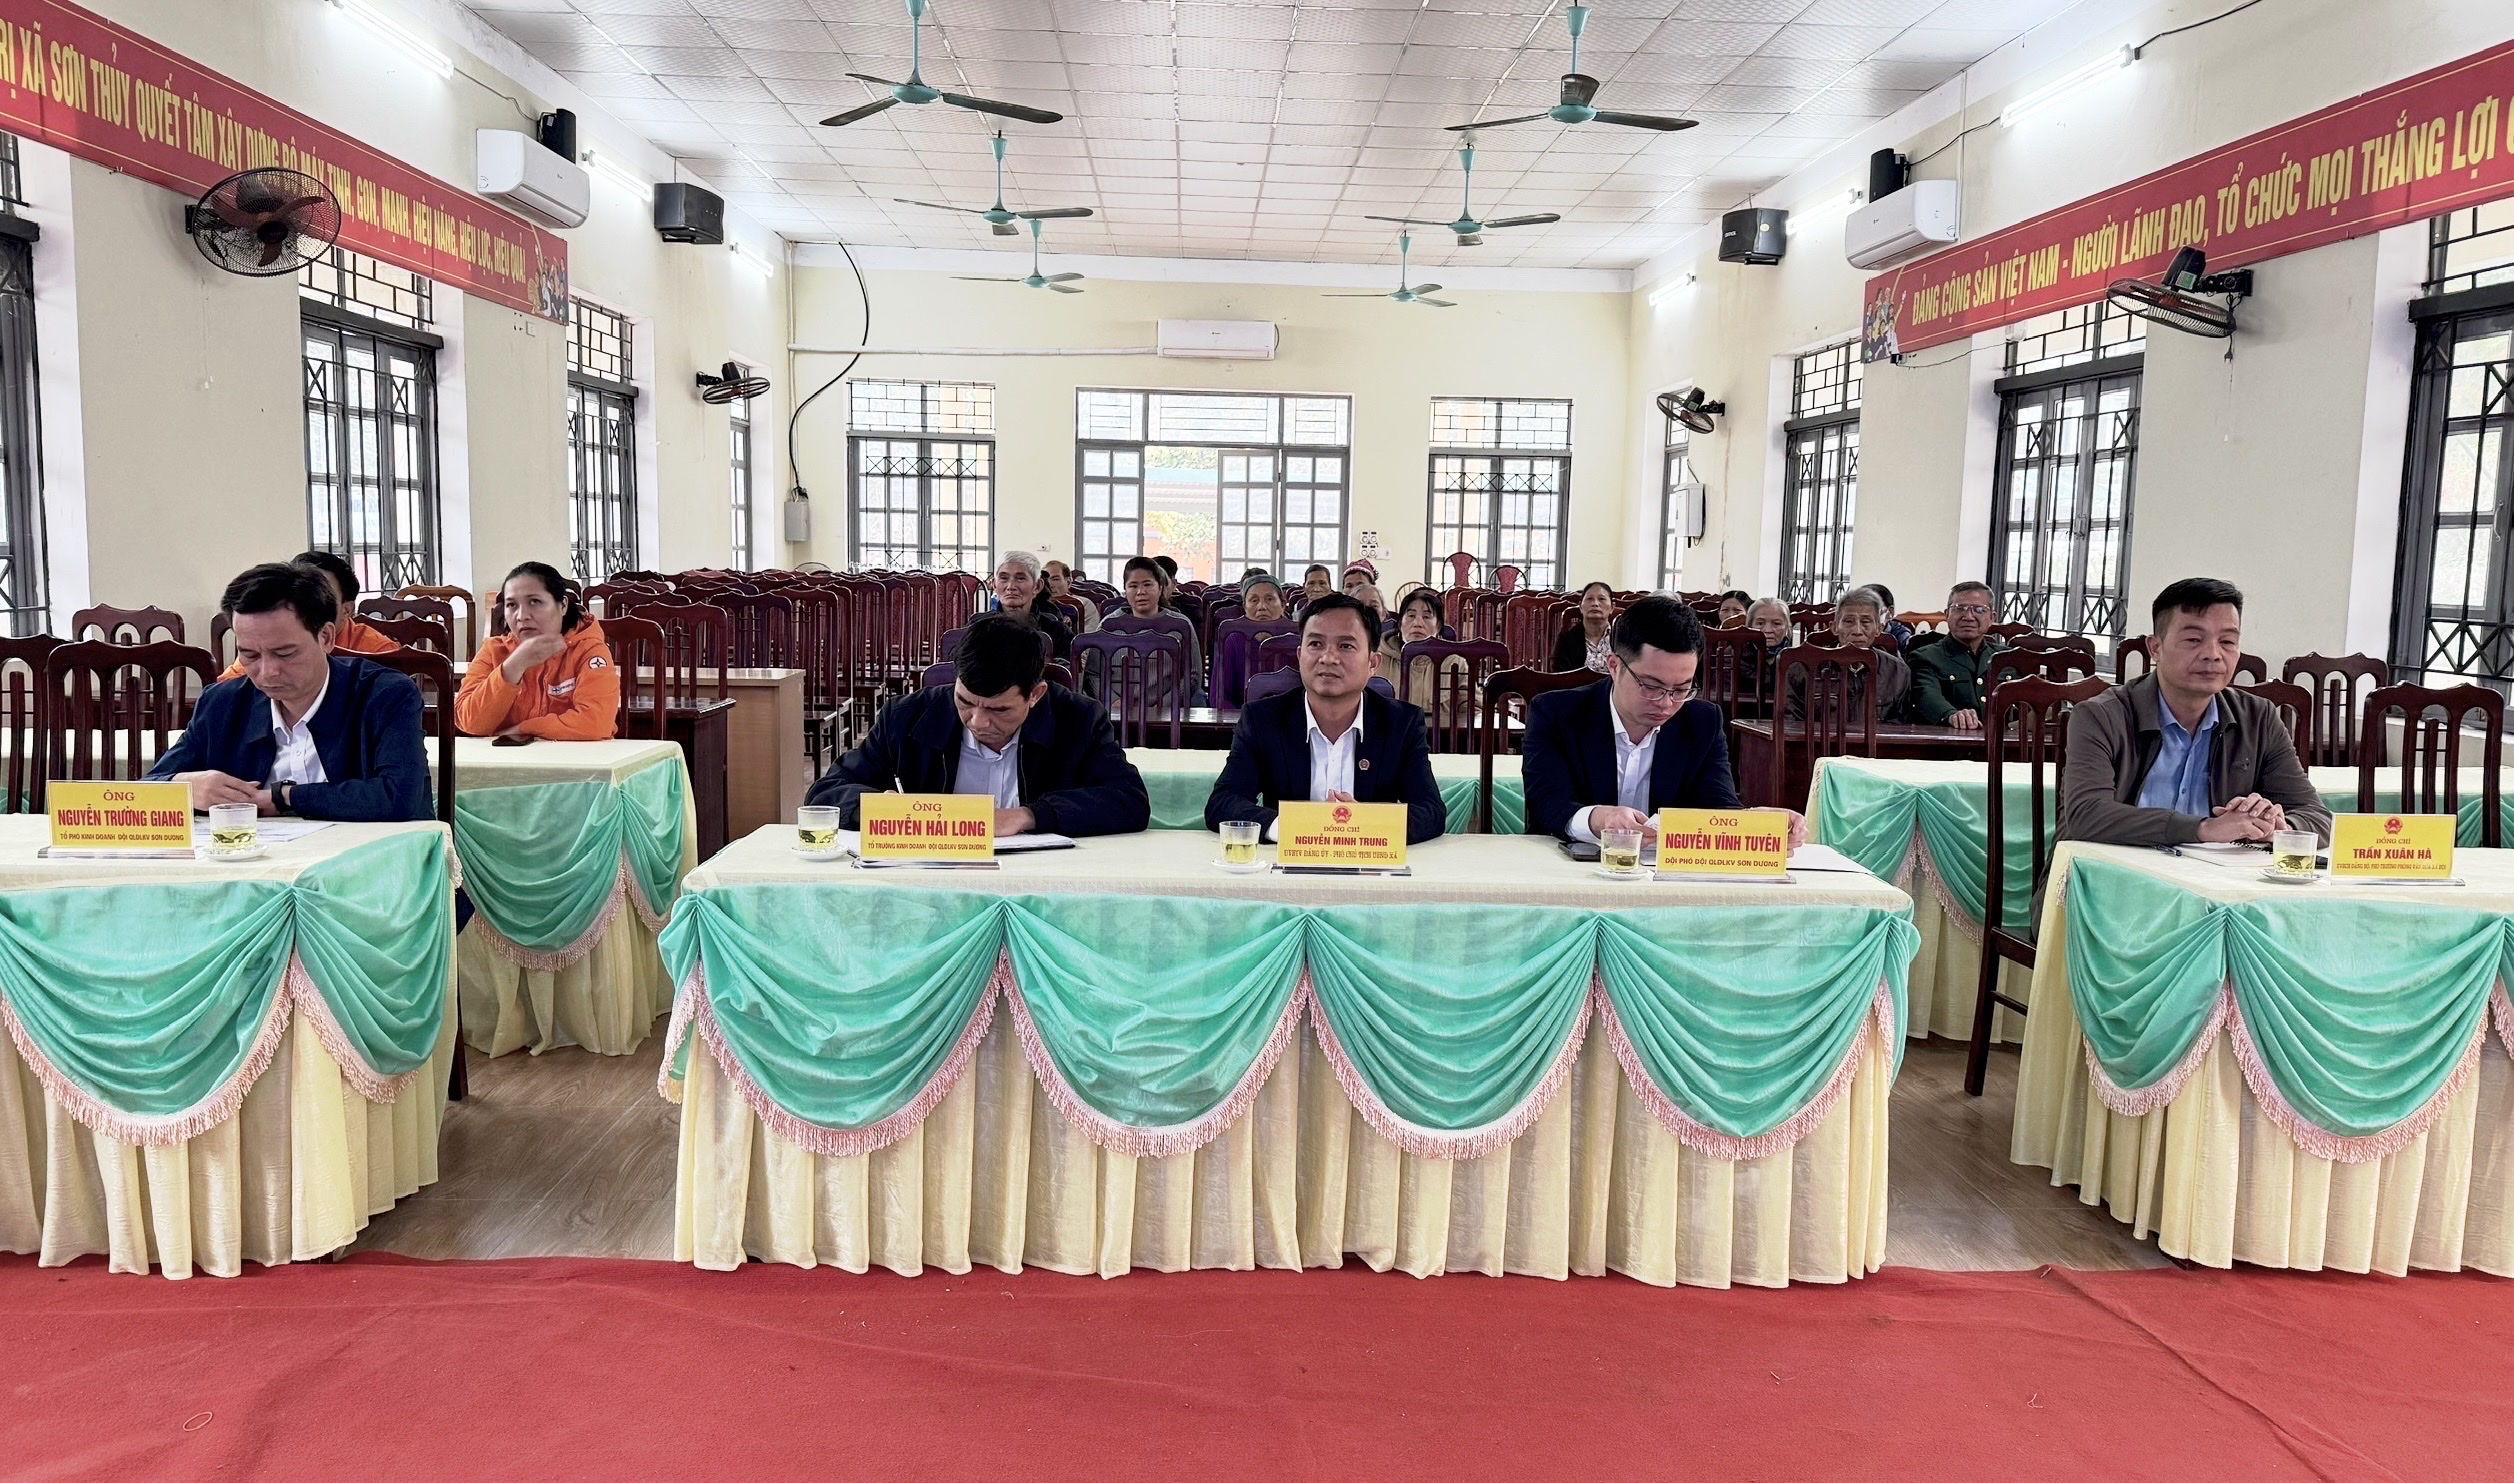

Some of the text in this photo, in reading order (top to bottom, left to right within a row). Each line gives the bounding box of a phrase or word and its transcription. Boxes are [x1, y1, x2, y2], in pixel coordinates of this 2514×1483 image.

[19, 21, 47, 97] XÃ
[50, 40, 87, 113] SƠN
[90, 42, 130, 129] THỦY
[135, 73, 181, 149] QUYẾT
[184, 92, 215, 162] TÂM
[217, 108, 242, 171] XÂY
[356, 175, 380, 233] GỌN,
[381, 186, 412, 245] MẠNH,
[413, 195, 432, 254] HIỆU
[434, 203, 458, 262] NĂNG,
[459, 215, 477, 271] HIỆU
[477, 228, 493, 276] LỰC,
[494, 231, 510, 284] HIỆU
[1912, 273, 1940, 326] ĐẢNG
[1941, 271, 1972, 323] CỘNG
[1973, 251, 1998, 308] SẢN
[1999, 249, 2026, 306] VIỆT
[2027, 243, 2061, 292] NAM
[2071, 214, 2119, 279] NGƯỜI
[2120, 206, 2166, 265] LÃNH
[2216, 161, 2244, 236] TỔ
[2244, 152, 2302, 229] CHỨC
[2306, 145, 2354, 217] MỌI
[2361, 109, 2446, 196] THẮNG
[2451, 95, 2500, 180] LỢI
[103, 789, 135, 802] ÔNG
[912, 801, 942, 812] ÔNG
[58, 804, 185, 827] NGUYỄN TRƯỜNG GIANG
[1709, 815, 1738, 827] ÔNG
[869, 813, 986, 837] NGUYỄN HẢI LONG
[1295, 833, 1388, 847] NGUYỄN MINH TRUNG
[1665, 828, 1781, 852] NGUYỄN VĨNH TUYÊN
[2384, 847, 2414, 859] XUÂN
[2418, 847, 2432, 860] HÀ
[1679, 857, 1693, 865] PHÓ
